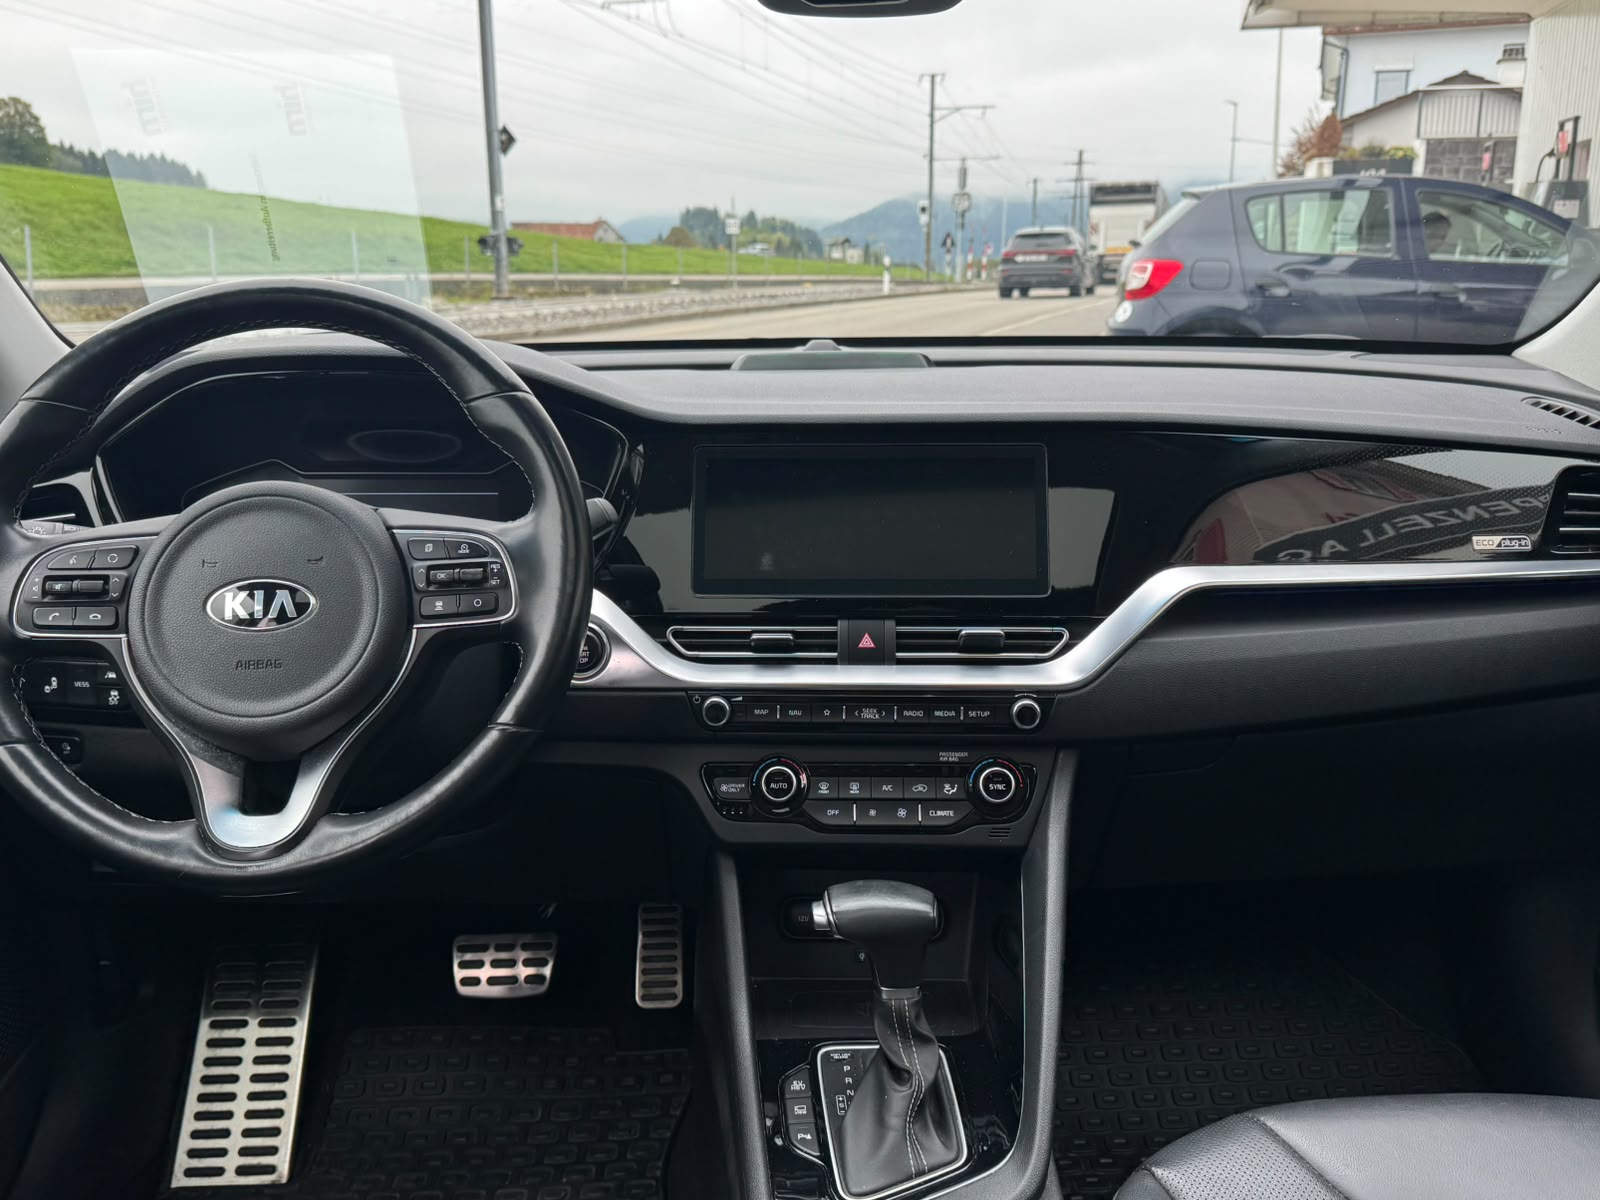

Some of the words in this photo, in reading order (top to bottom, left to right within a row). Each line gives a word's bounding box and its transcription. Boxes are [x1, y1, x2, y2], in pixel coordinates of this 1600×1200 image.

[1475, 539, 1495, 547] ECO
[1501, 537, 1530, 548] plug-in
[223, 590, 298, 620] KIA
[235, 659, 282, 671] AIRBAG
[769, 782, 788, 790] AUTO
